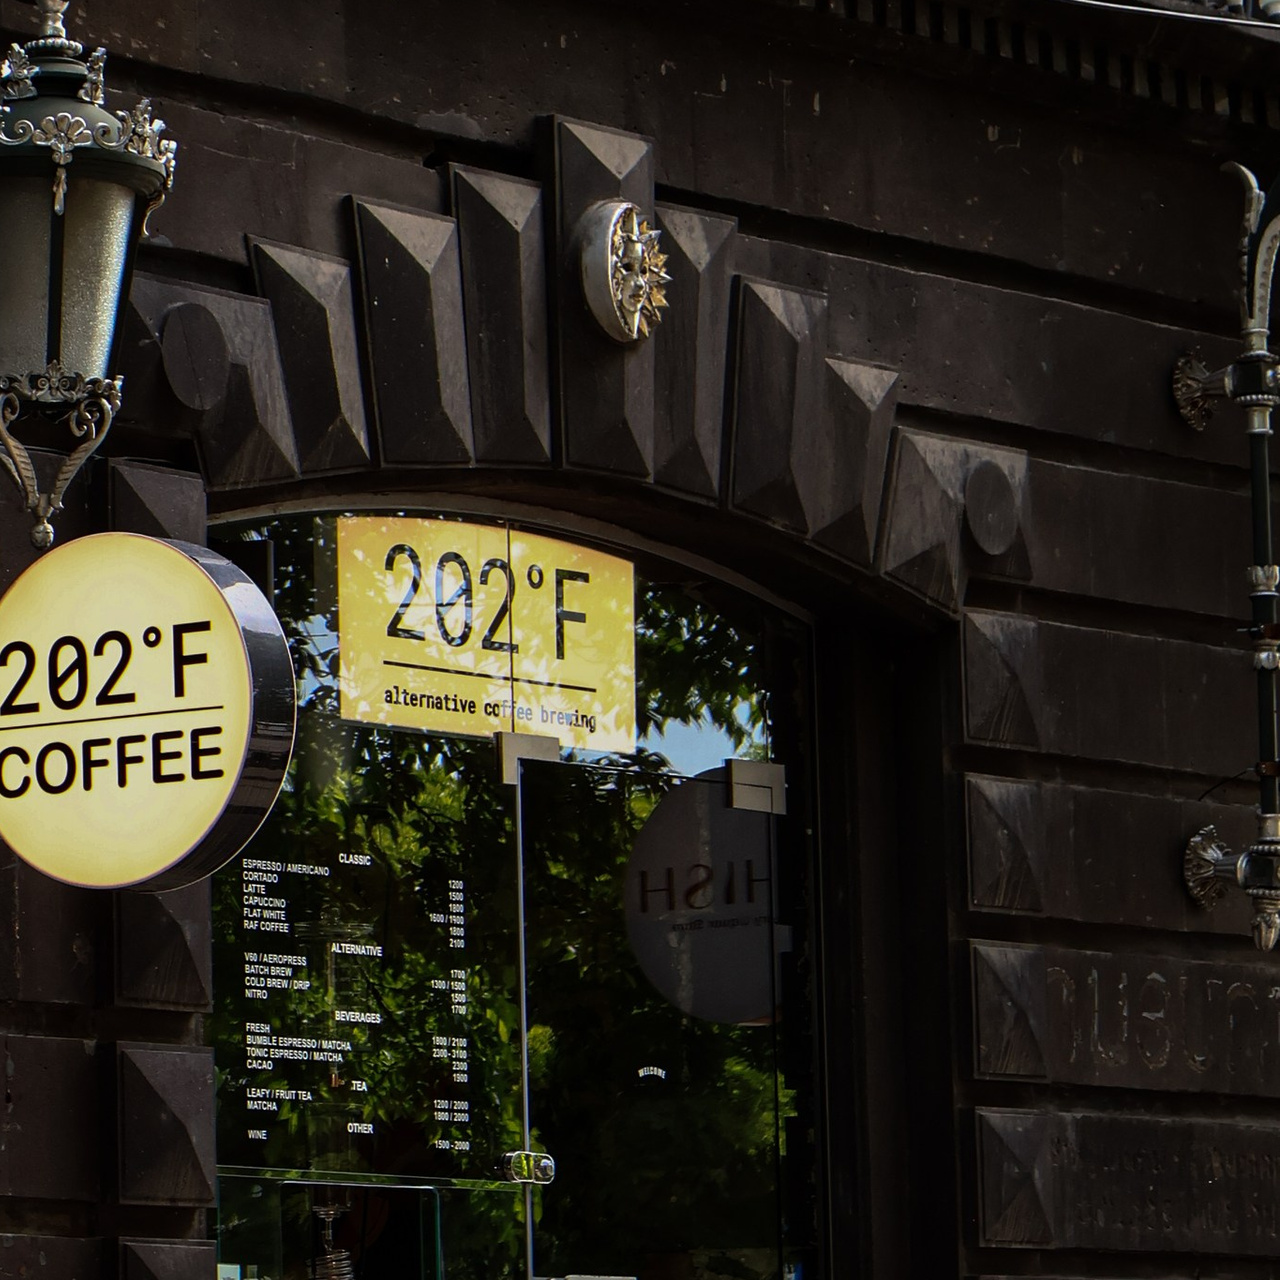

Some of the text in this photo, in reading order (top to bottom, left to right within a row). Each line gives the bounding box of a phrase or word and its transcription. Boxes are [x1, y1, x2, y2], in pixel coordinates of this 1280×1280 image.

[384, 543, 590, 660] 202°F
[384, 685, 597, 733] alternative coffee brewing
[339, 853, 372, 866] CLASSIC
[242, 858, 282, 872] ESPRESSO
[286, 864, 330, 876] AMERICANO
[243, 871, 279, 883] CORTADO
[243, 883, 266, 894] LATTE
[448, 879, 464, 890] 1200
[243, 895, 287, 908] CAPUCCINO
[448, 891, 464, 901] 1500
[243, 907, 286, 921] FLAT WHITE
[243, 919, 290, 933] RAF COFFEE
[331, 942, 383, 957] ALTERNATIVE
[449, 938, 465, 948] 2100
[244, 952, 258, 962] V60
[263, 953, 307, 966] AEROPRESS
[245, 964, 293, 977] BATCH BREW
[450, 969, 466, 979] 1700
[245, 976, 266, 987] COLD
[266, 978, 289, 989] BREW
[293, 980, 311, 990] DRIP
[450, 981, 466, 991] 1500
[245, 989, 268, 1000] NITRO
[451, 1005, 467, 1015] 1700
[335, 1010, 381, 1024] BEVERAGES
[246, 1022, 271, 1033] FRESH
[246, 1035, 278, 1046] BUMBLE
[278, 1037, 317, 1048] ESPRESSO
[321, 1040, 352, 1051] MATCHA
[246, 1047, 269, 1059] TONIC
[270, 1048, 308, 1060] ESPRESSO
[313, 1052, 343, 1062] MATCHA
[246, 1059, 274, 1070] CACAO
[352, 1080, 368, 1092] TEA
[246, 1088, 271, 1099] LEAFY
[275, 1090, 297, 1100] FRUIT
[297, 1090, 313, 1101] TEA
[246, 1100, 278, 1111] MATCHA
[433, 1099, 449, 1109] 1200
[248, 1129, 268, 1140] WINE
[347, 1122, 374, 1135] OTHER
